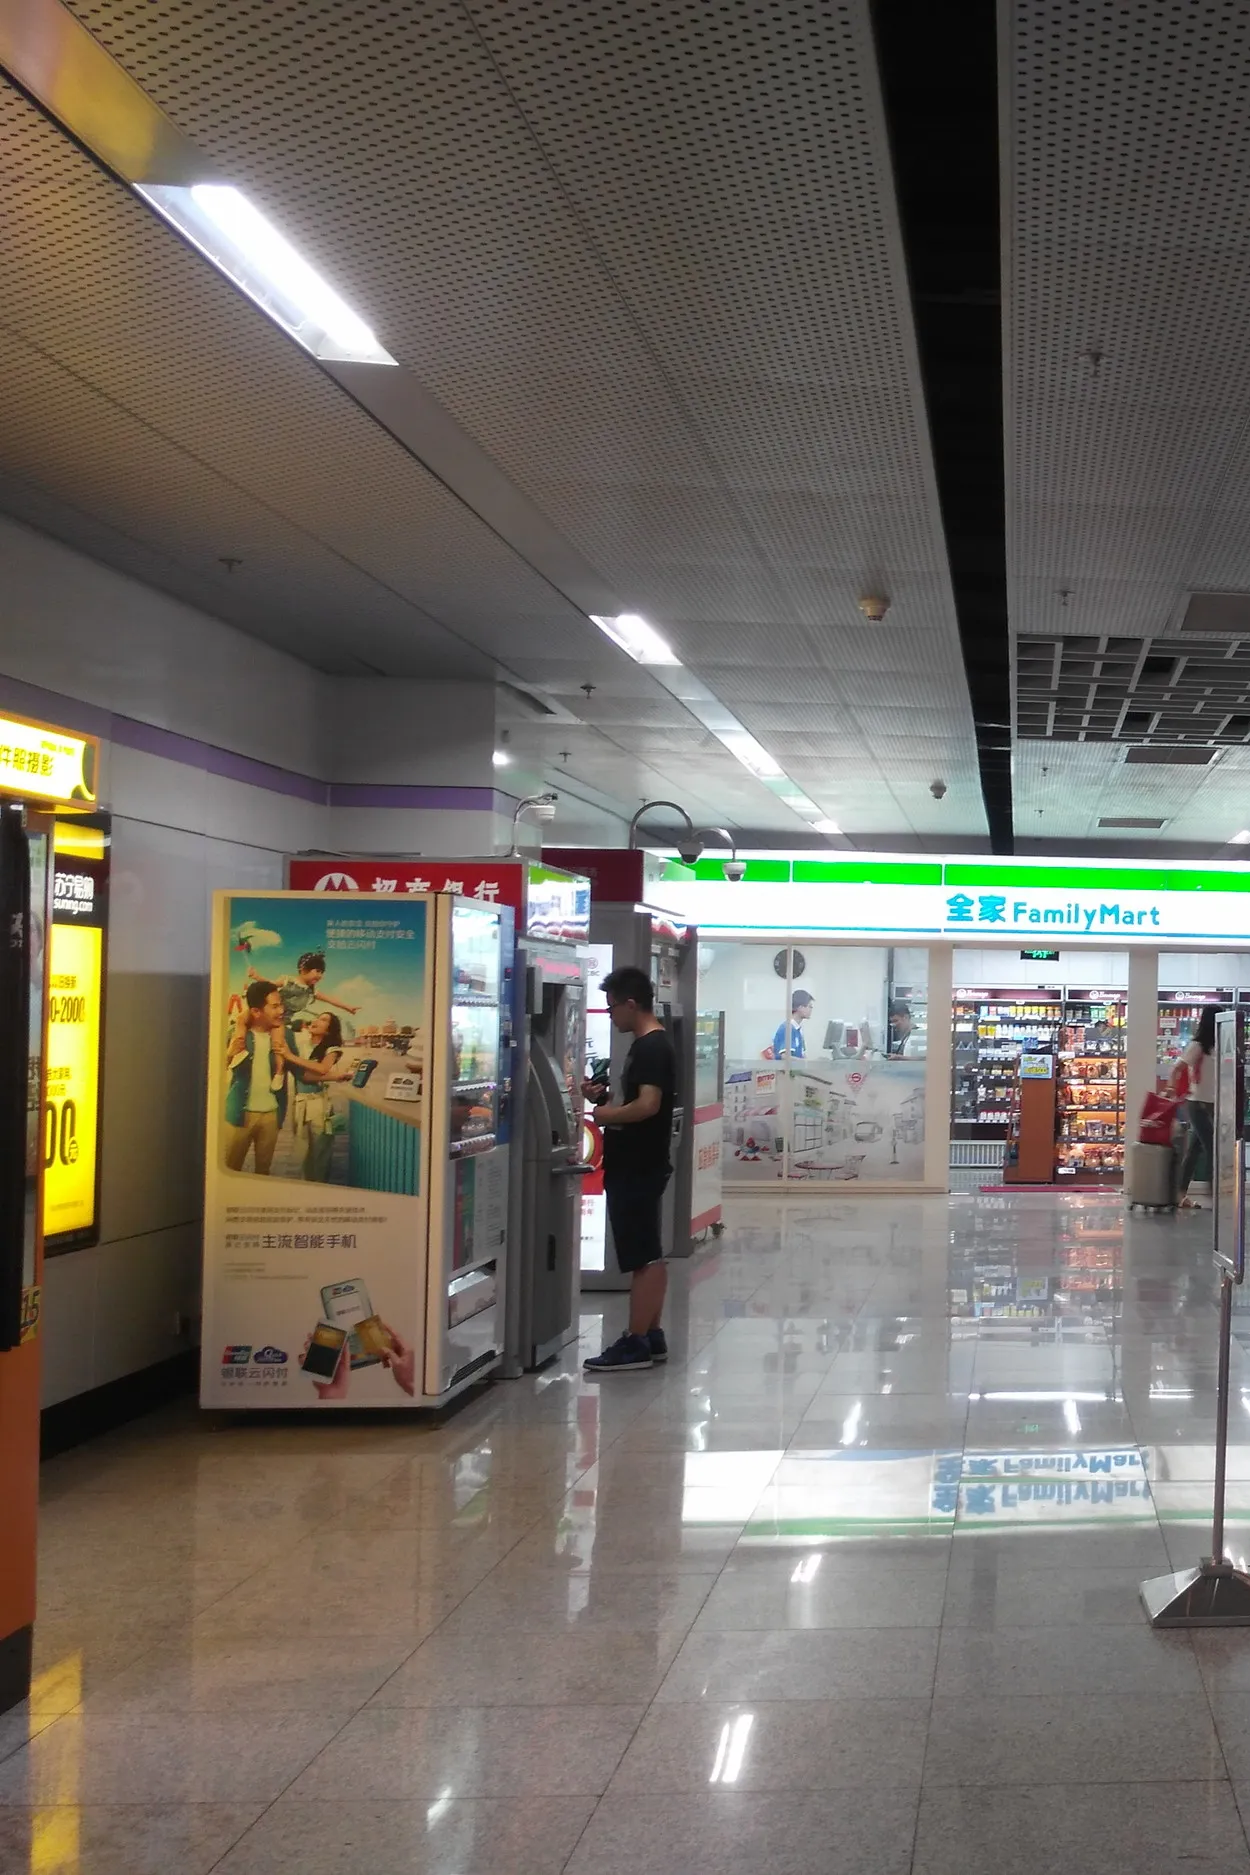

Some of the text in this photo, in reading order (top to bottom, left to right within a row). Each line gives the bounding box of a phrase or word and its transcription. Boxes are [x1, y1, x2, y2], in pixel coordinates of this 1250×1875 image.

[54, 872, 95, 900] 苏宁易购
[53, 898, 94, 915] suning.com
[946, 893, 1160, 931] 全家 FamilyMart
[262, 1233, 357, 1249] 主流智能手机
[221, 1367, 288, 1379] 银联云闪付
